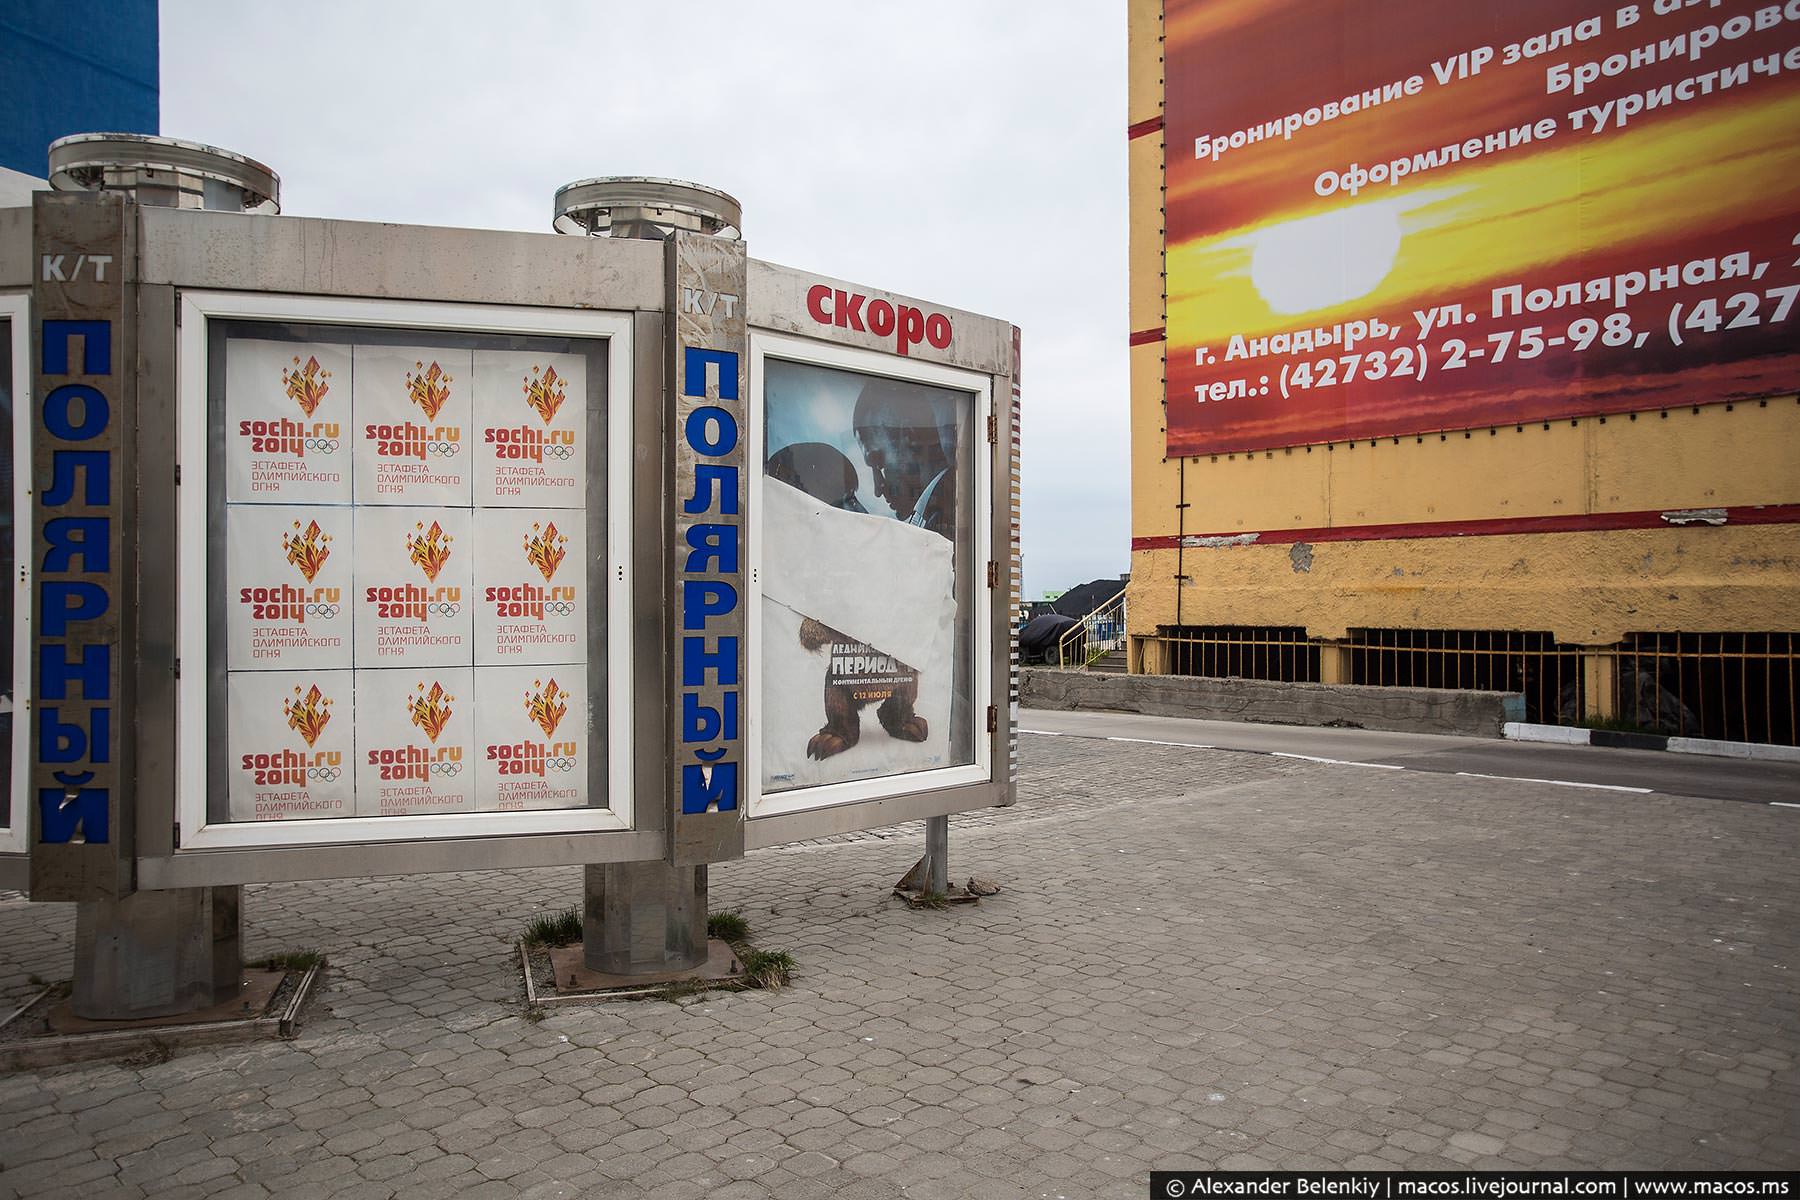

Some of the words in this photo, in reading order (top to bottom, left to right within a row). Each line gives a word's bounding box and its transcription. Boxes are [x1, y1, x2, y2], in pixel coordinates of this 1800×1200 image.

[1195, 75, 1424, 161] Бронирование
[1431, 46, 1494, 85] VIP
[1502, 16, 1601, 65] зала
[1616, 5, 1640, 29] в
[1314, 118, 1556, 196] Оформление
[42, 254, 113, 282] К/Т
[684, 287, 739, 319] К/Т
[1195, 346, 1216, 366] г.
[1224, 318, 1401, 361] Анадырь,
[1413, 303, 1477, 340] ул.
[1491, 251, 1770, 318] Полярная,
[1194, 375, 1269, 403] тел.:
[1280, 343, 1428, 399] (42732)
[1440, 312, 1650, 370] 2-75-98,
[240, 418, 339, 438] sochi.ru
[366, 421, 460, 442] sochi.ru
[484, 425, 575, 445] sochi.ru
[251, 437, 304, 457] 2014
[377, 441, 426, 460] 2014
[495, 444, 543, 463] 2014
[251, 461, 307, 470] ЭСТАФЕТА
[377, 464, 430, 473] ЭСТАФЕТА
[495, 466, 545, 475] ЭСТАФЕТА
[251, 471, 340, 482] ОЛИМПИЙСКОГО
[377, 474, 460, 484] ОЛИМПИЙСКОГО
[495, 476, 575, 486] ОЛИМПИЙСКОГО
[251, 482, 280, 492] ОГНЯ
[377, 484, 404, 493] ОГНЯ
[495, 487, 521, 495] ОГНЯ
[39, 319, 112, 844] ПОЛЯРНЫЙ
[683, 346, 739, 815] ПОЛЯРНЫЙ
[240, 584, 340, 603] sochi.ru
[366, 583, 461, 602] sochi.ru
[485, 583, 576, 602] sochi.ru
[252, 603, 305, 623] 2014
[378, 603, 427, 622] 2014
[496, 602, 544, 620] 2014
[253, 628, 308, 637] ЭСТАФЕТА
[378, 626, 430, 635] ЭСТАФЕТА
[497, 624, 547, 633] ЭСТАФЕТА
[253, 637, 341, 648] ОЛИМПИЙСКОГО
[378, 636, 461, 645] ОЛИМПИЙСКОГО
[497, 633, 576, 644] ОЛИМПИЙСКОГО
[253, 649, 281, 658] ОГНЯ
[378, 647, 405, 656] ОГНЯ
[497, 645, 522, 654] ОГНЯ
[832, 656, 897, 675] ПЕРИОД
[868, 690, 892, 699] ИЮЛЯ
[242, 749, 342, 769] sochi.ru
[368, 745, 462, 765] sochi.ru
[486, 740, 577, 760] sochi.ru
[380, 764, 429, 782] 2014
[498, 759, 545, 777] 2014
[254, 769, 306, 787] 2014
[498, 781, 548, 791] ЭСТАФЕТА
[255, 791, 310, 801] ЭСТАФЕТА
[380, 786, 433, 797] ЭСТАФЕТА
[498, 789, 577, 801] ОЛИМПИЙСКОГО
[255, 800, 342, 812] ОЛИМПИЙСКОГО
[380, 795, 463, 808] ОЛИМПИЙСКОГО
